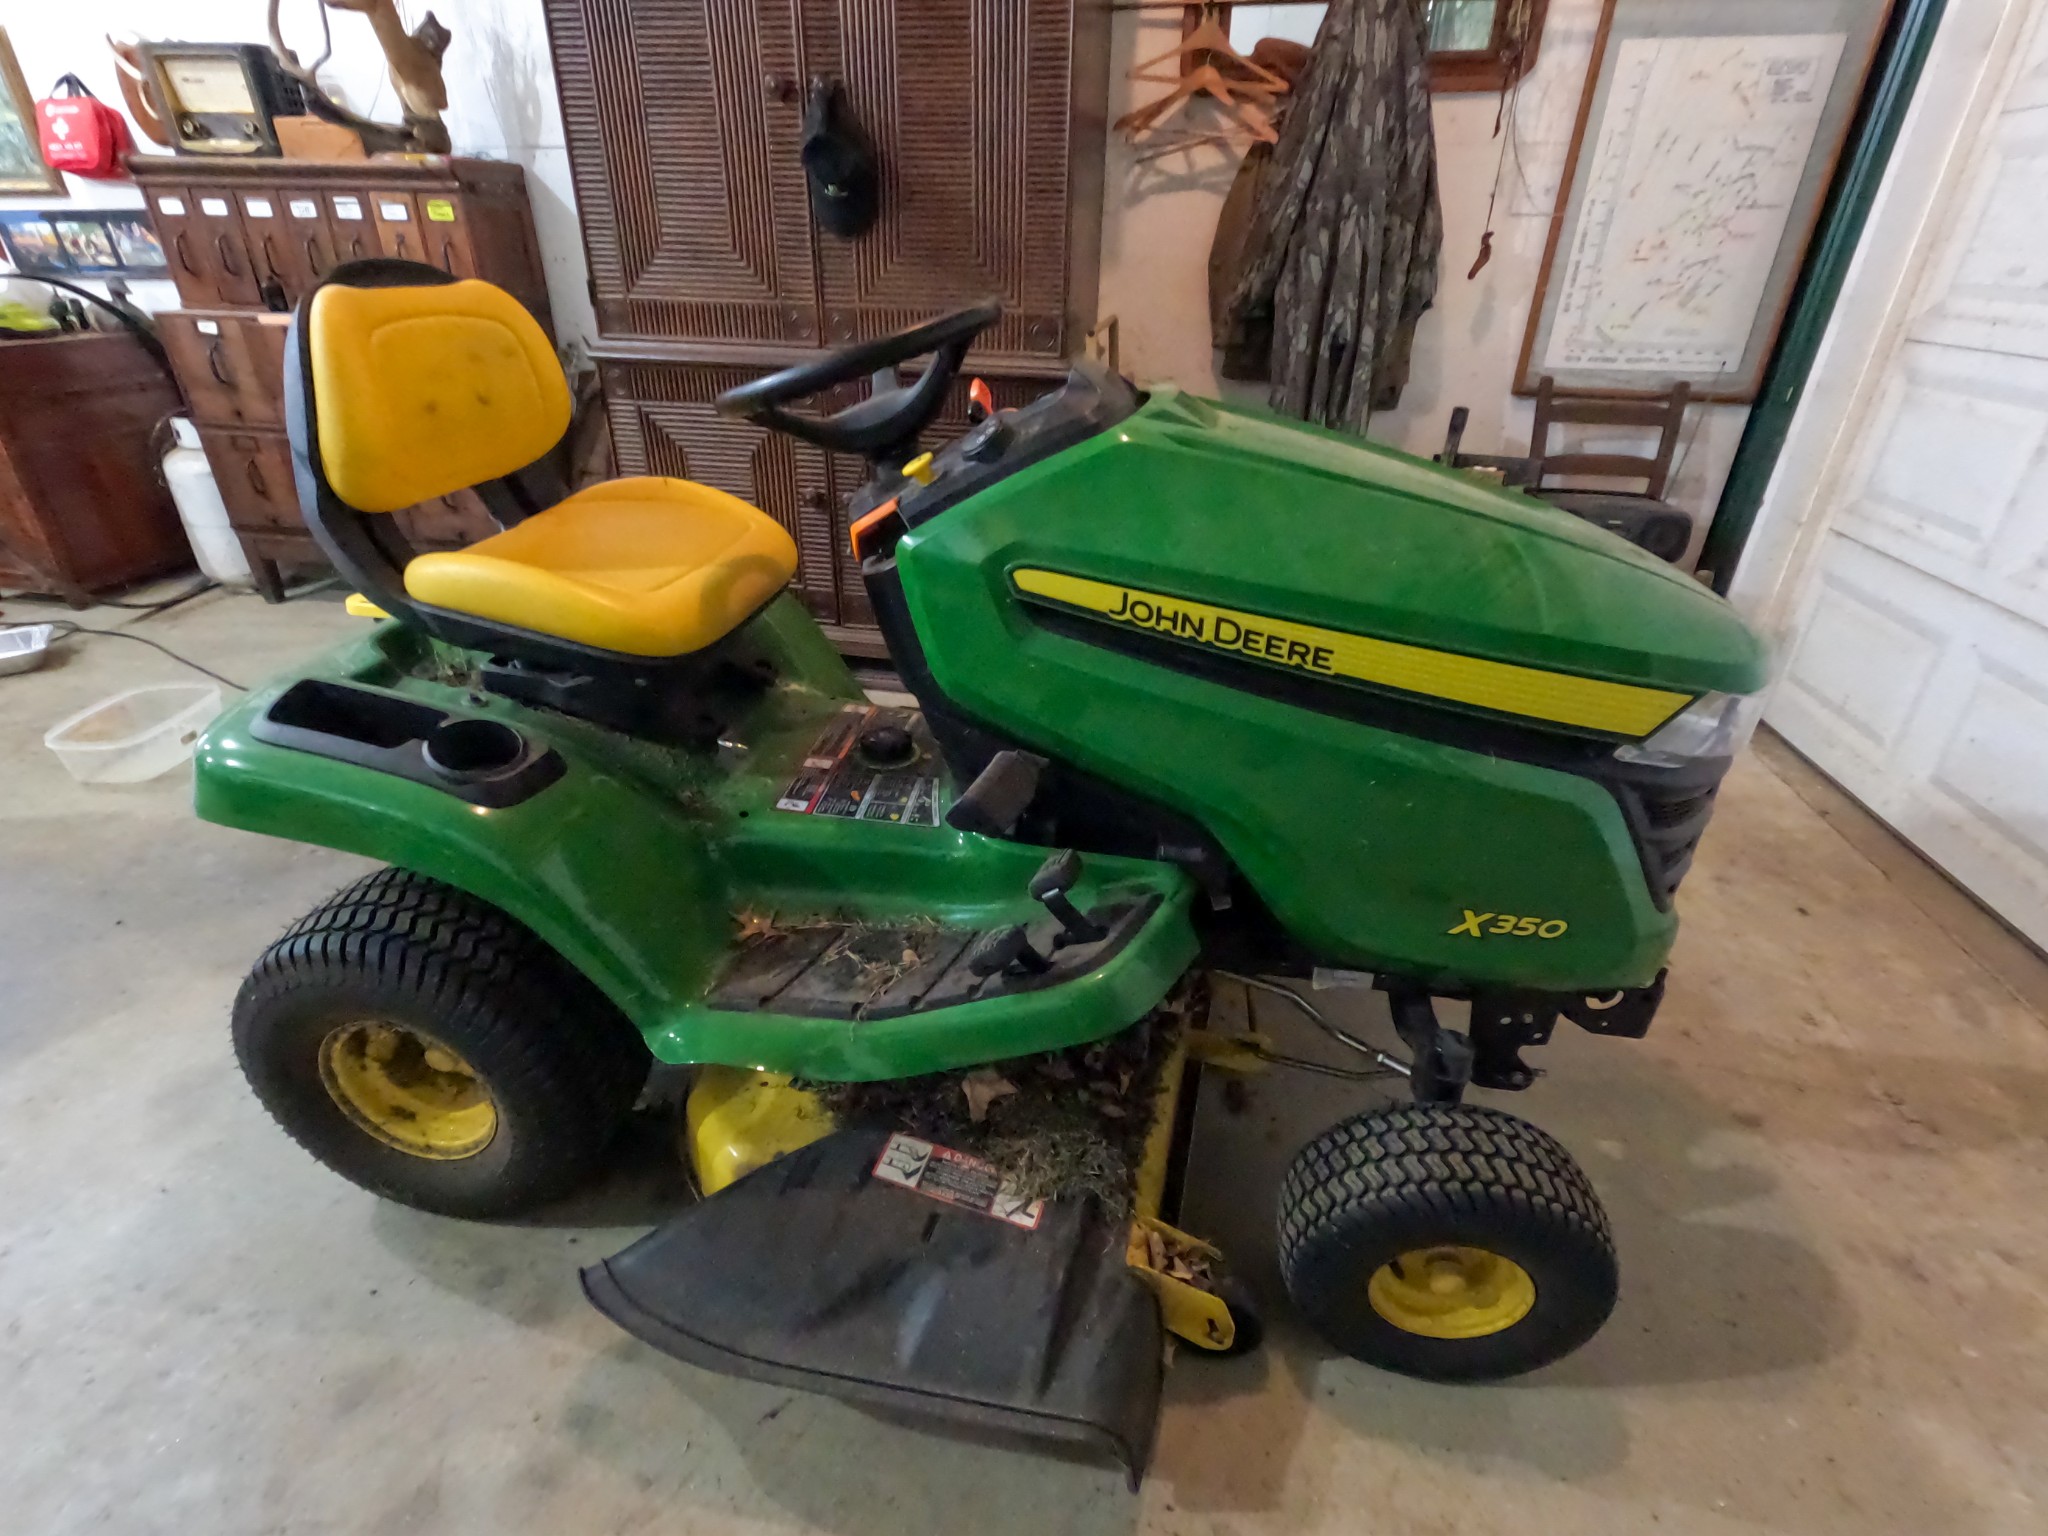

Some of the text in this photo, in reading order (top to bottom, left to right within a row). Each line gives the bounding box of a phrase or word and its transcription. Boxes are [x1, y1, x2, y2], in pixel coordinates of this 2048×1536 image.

[1108, 591, 1335, 671] JOHN DEERE
[1446, 909, 1568, 939] X350
